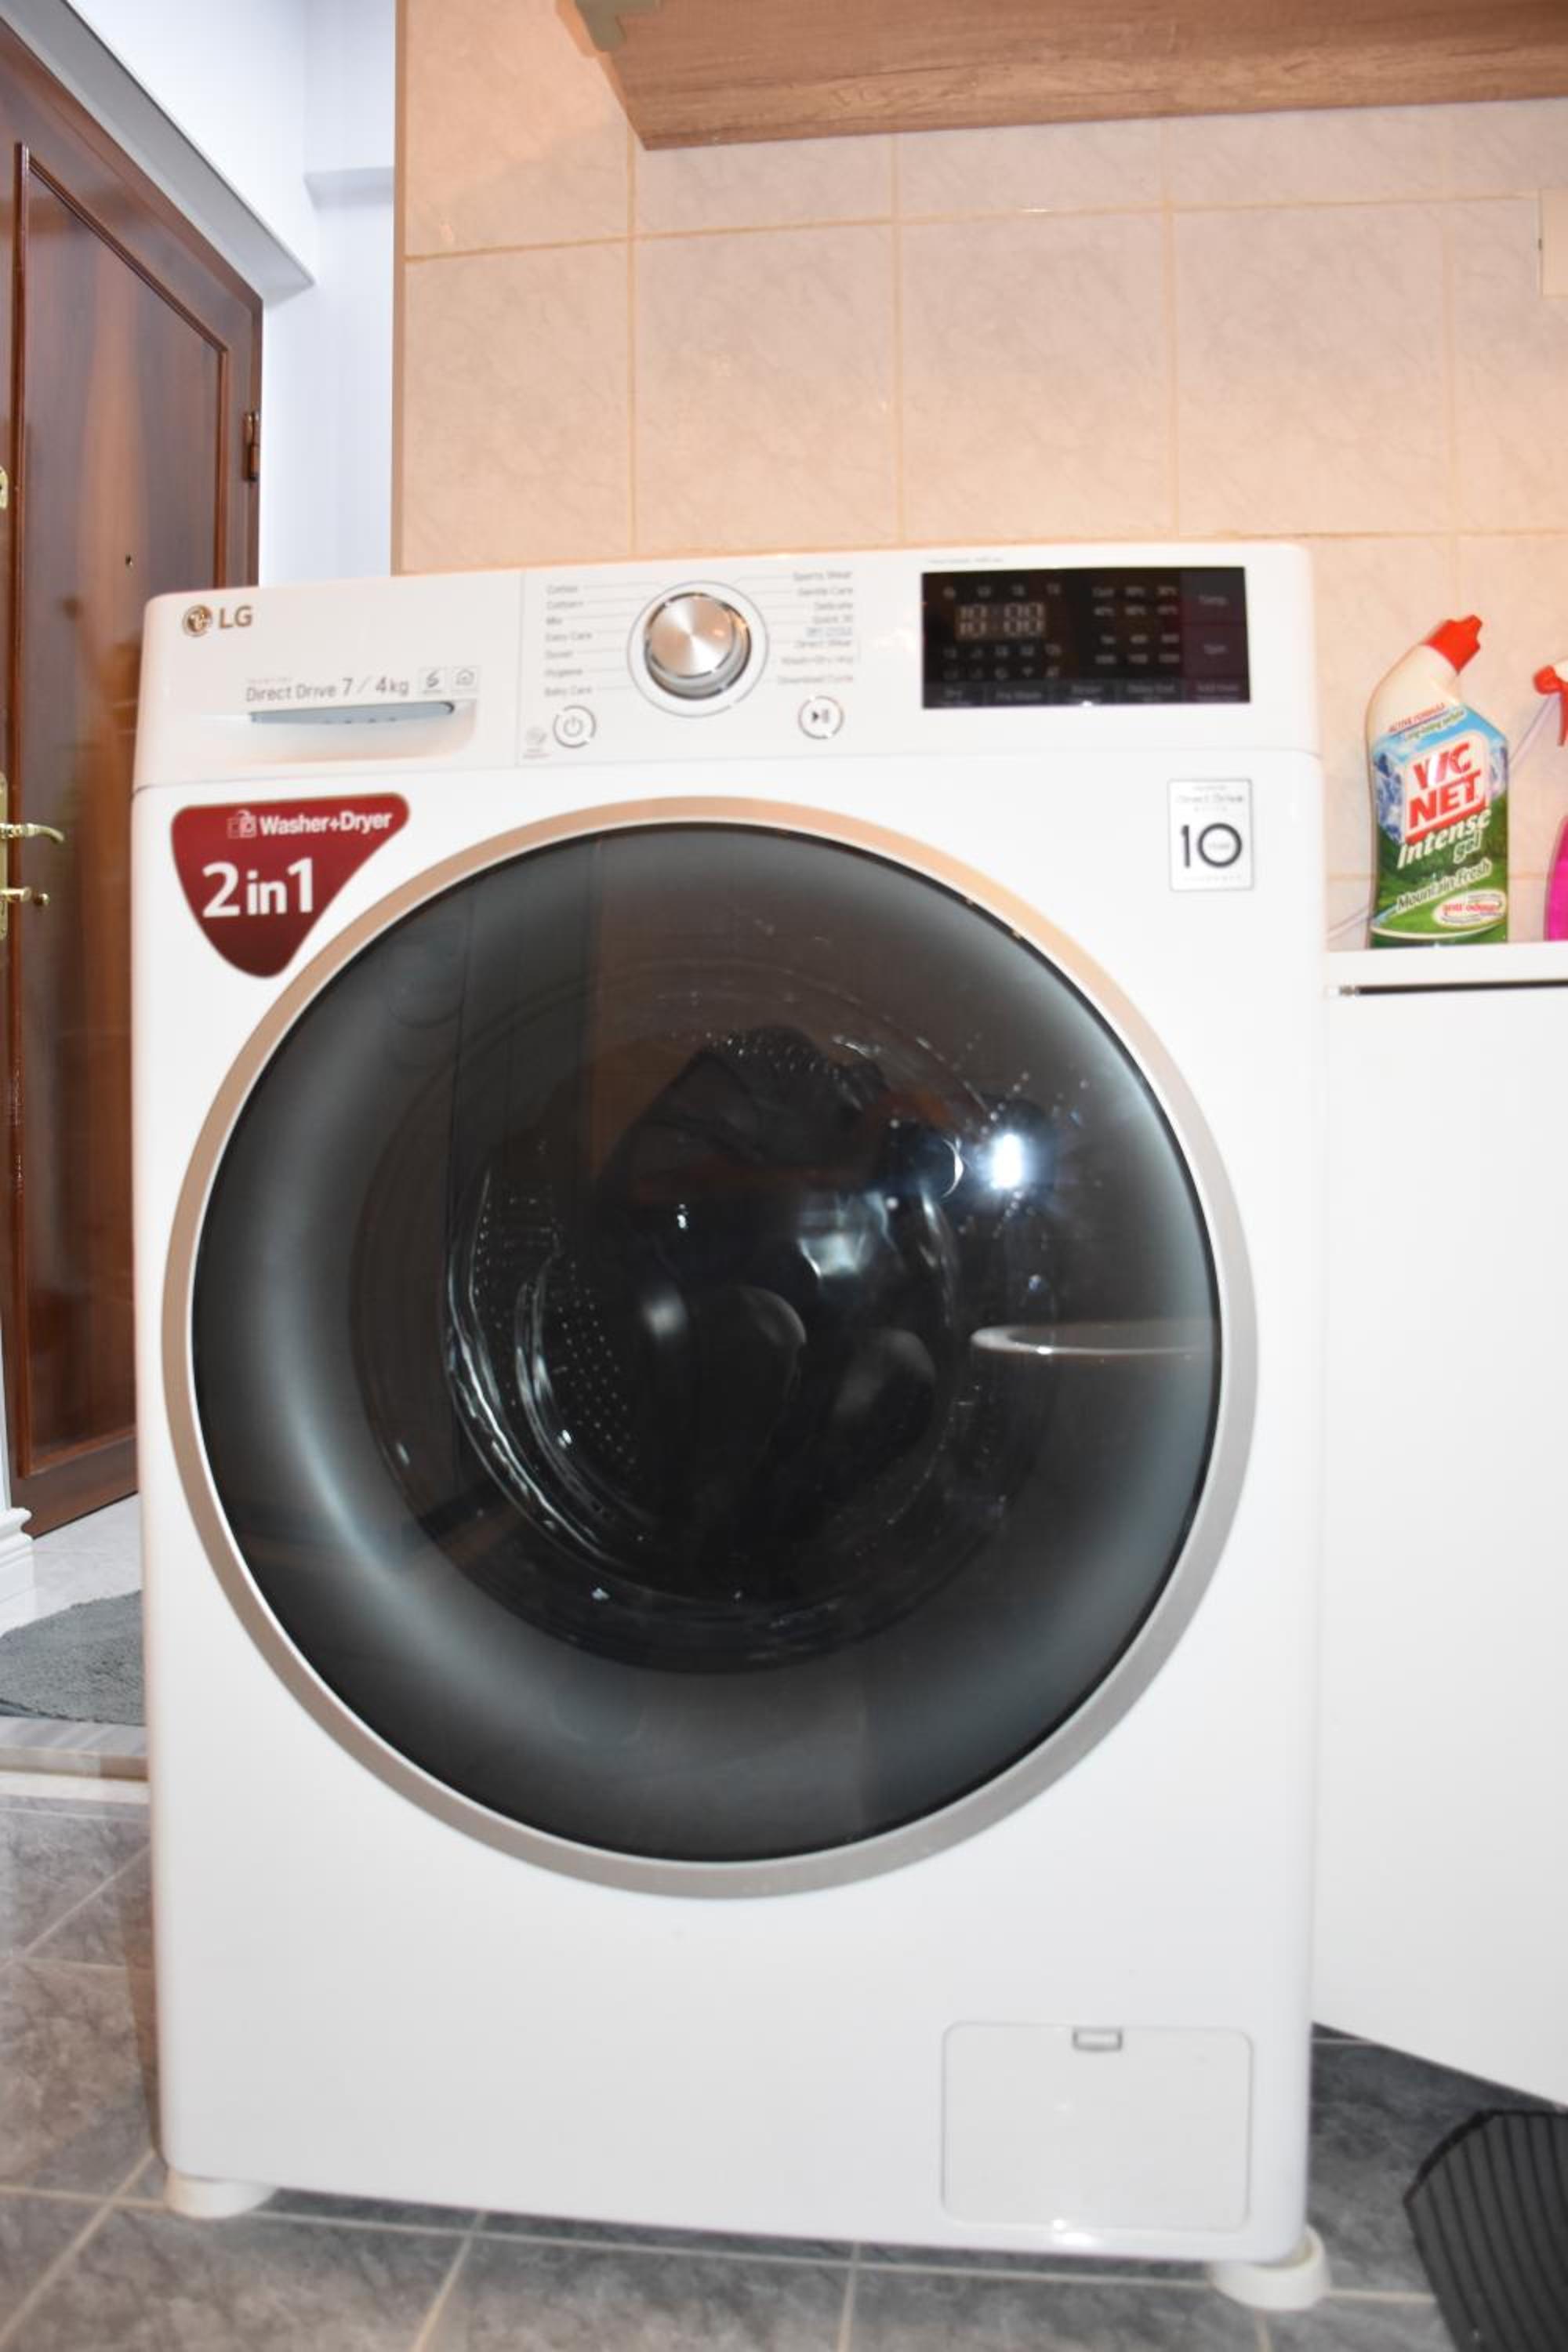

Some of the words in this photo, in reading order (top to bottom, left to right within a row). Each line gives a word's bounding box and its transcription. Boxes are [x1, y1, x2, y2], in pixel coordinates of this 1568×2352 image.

[219, 605, 253, 630] LG
[246, 685, 292, 702] Direct
[296, 683, 337, 699] Drive
[1409, 768, 1481, 829] NET
